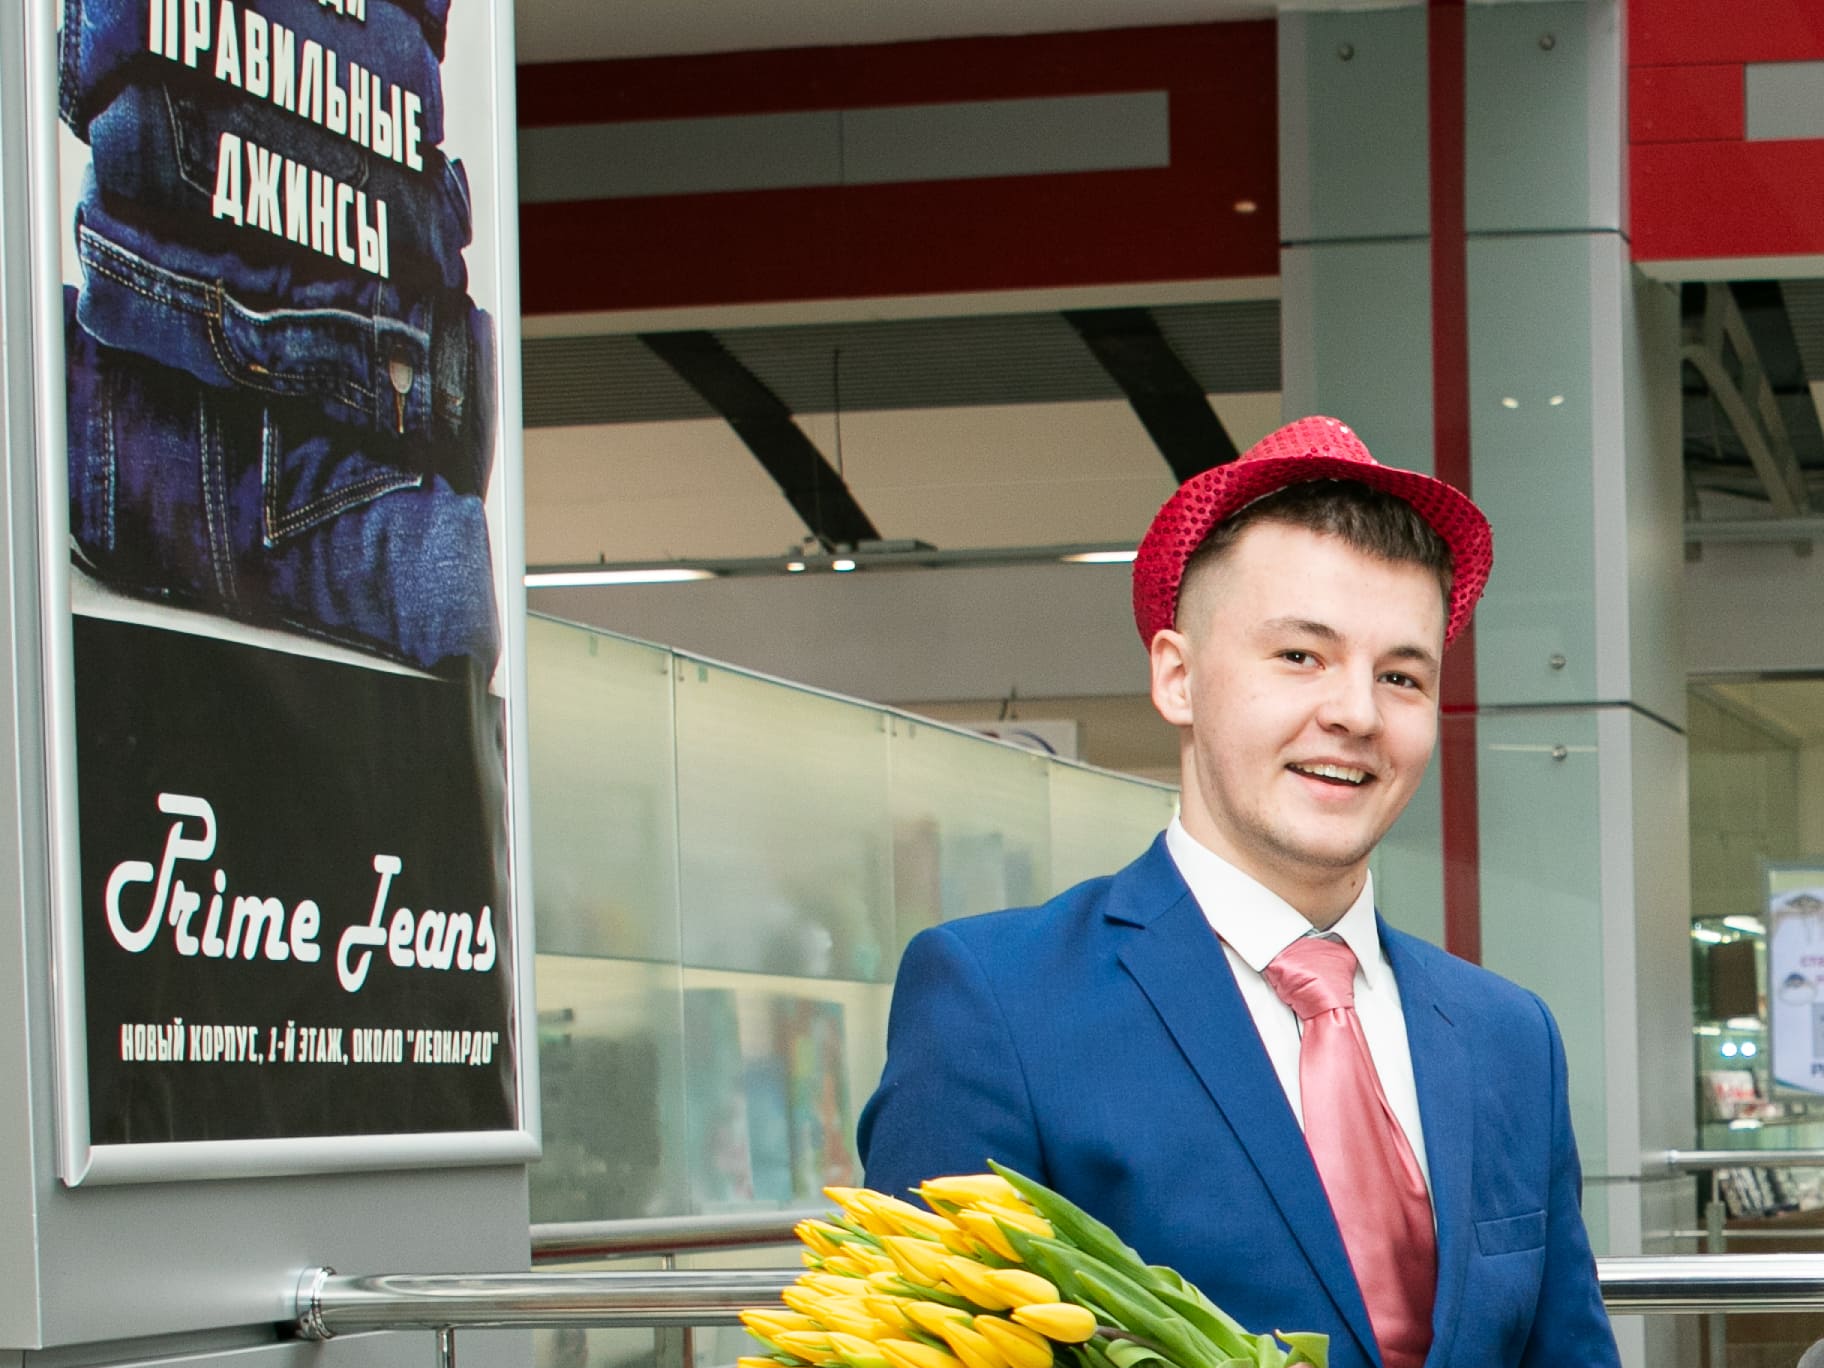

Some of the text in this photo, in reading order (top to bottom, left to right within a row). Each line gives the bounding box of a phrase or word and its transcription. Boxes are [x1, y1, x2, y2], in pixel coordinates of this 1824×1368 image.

[148, 0, 423, 172] ПРАВИЛЬНЫЕ
[211, 131, 389, 279] ДЖИНСЫ
[105, 792, 496, 992] Prime Jeans
[121, 1017, 186, 1061] НОВЫЙ
[189, 1025, 264, 1065] КОРПУС,
[299, 1028, 349, 1065] ЭТАЖ,
[352, 1029, 403, 1062] ОКОЛО
[406, 1030, 499, 1066] "ЛЕОНАРДО"
